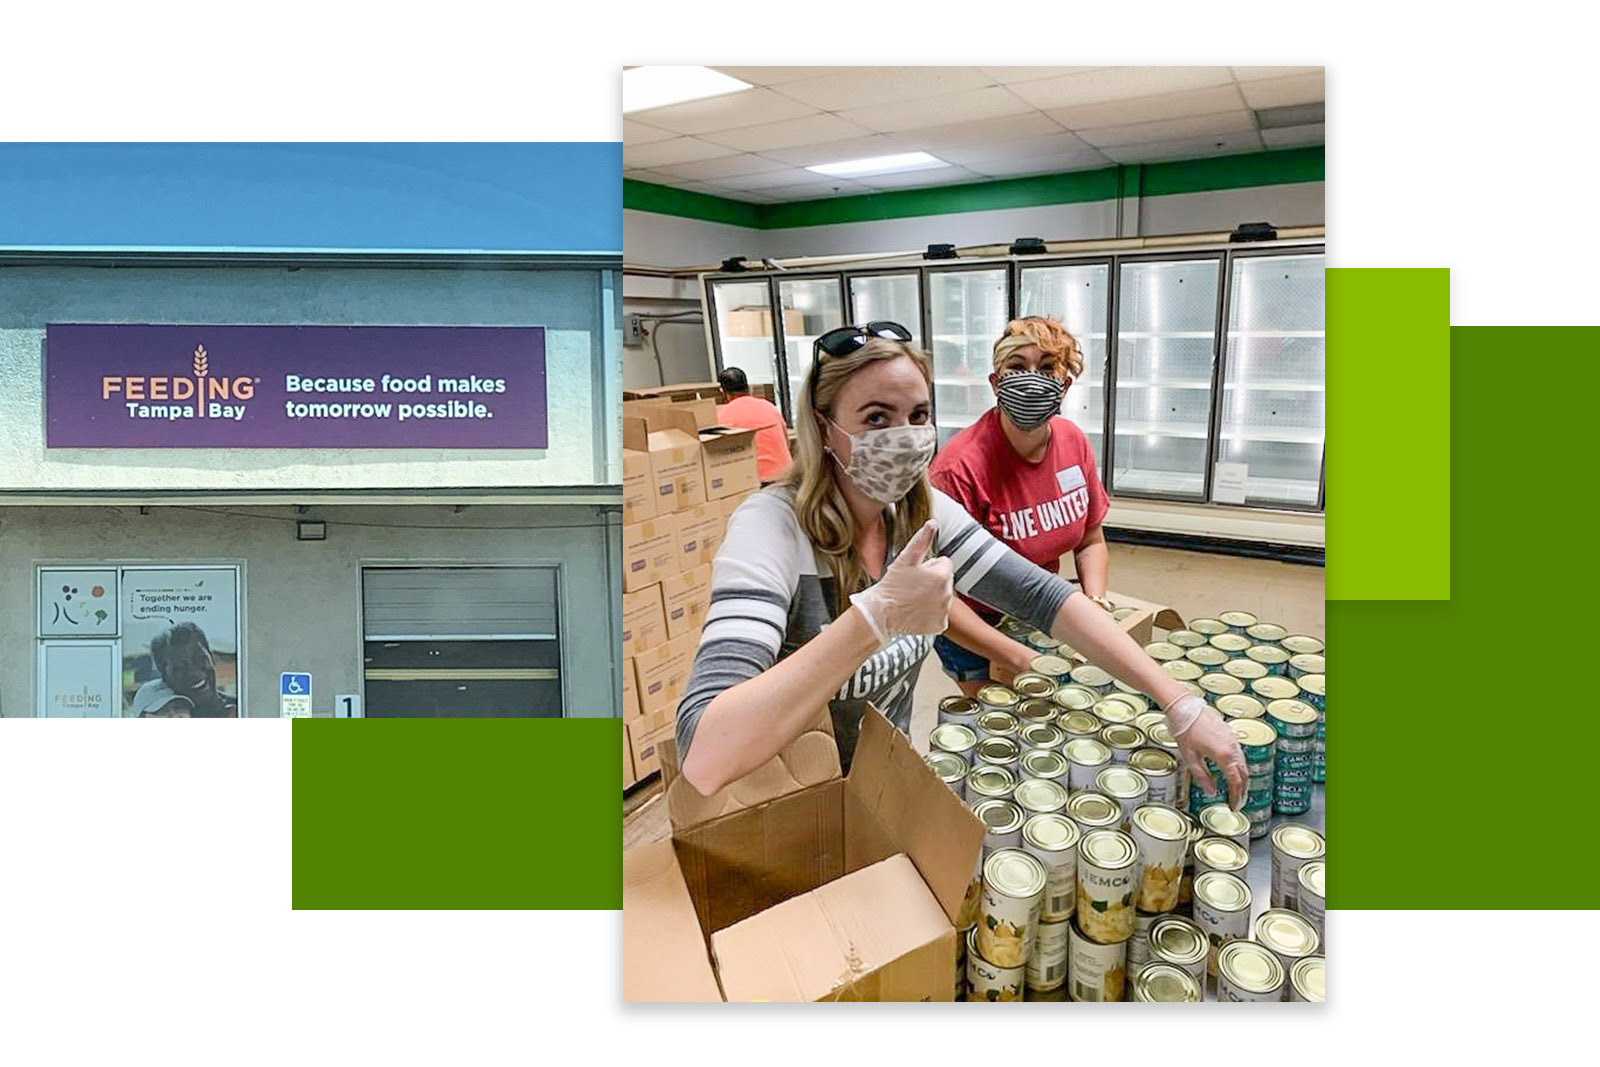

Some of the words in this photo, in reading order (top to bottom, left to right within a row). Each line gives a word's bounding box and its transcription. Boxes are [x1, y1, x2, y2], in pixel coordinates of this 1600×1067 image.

[102, 376, 255, 401] FEEDING
[286, 374, 375, 393] Because
[381, 374, 432, 393] food
[438, 375, 506, 393] makes
[126, 402, 194, 421] Tampa
[209, 402, 246, 421] Bay
[286, 400, 392, 418] tomorrow
[398, 400, 493, 421] possible.
[999, 507, 1039, 541] LIVE
[1036, 486, 1090, 533] UNITED
[139, 594, 181, 604] Together
[140, 605, 172, 614] ending
[174, 605, 208, 614] hunger.
[342, 696, 352, 718] 1
